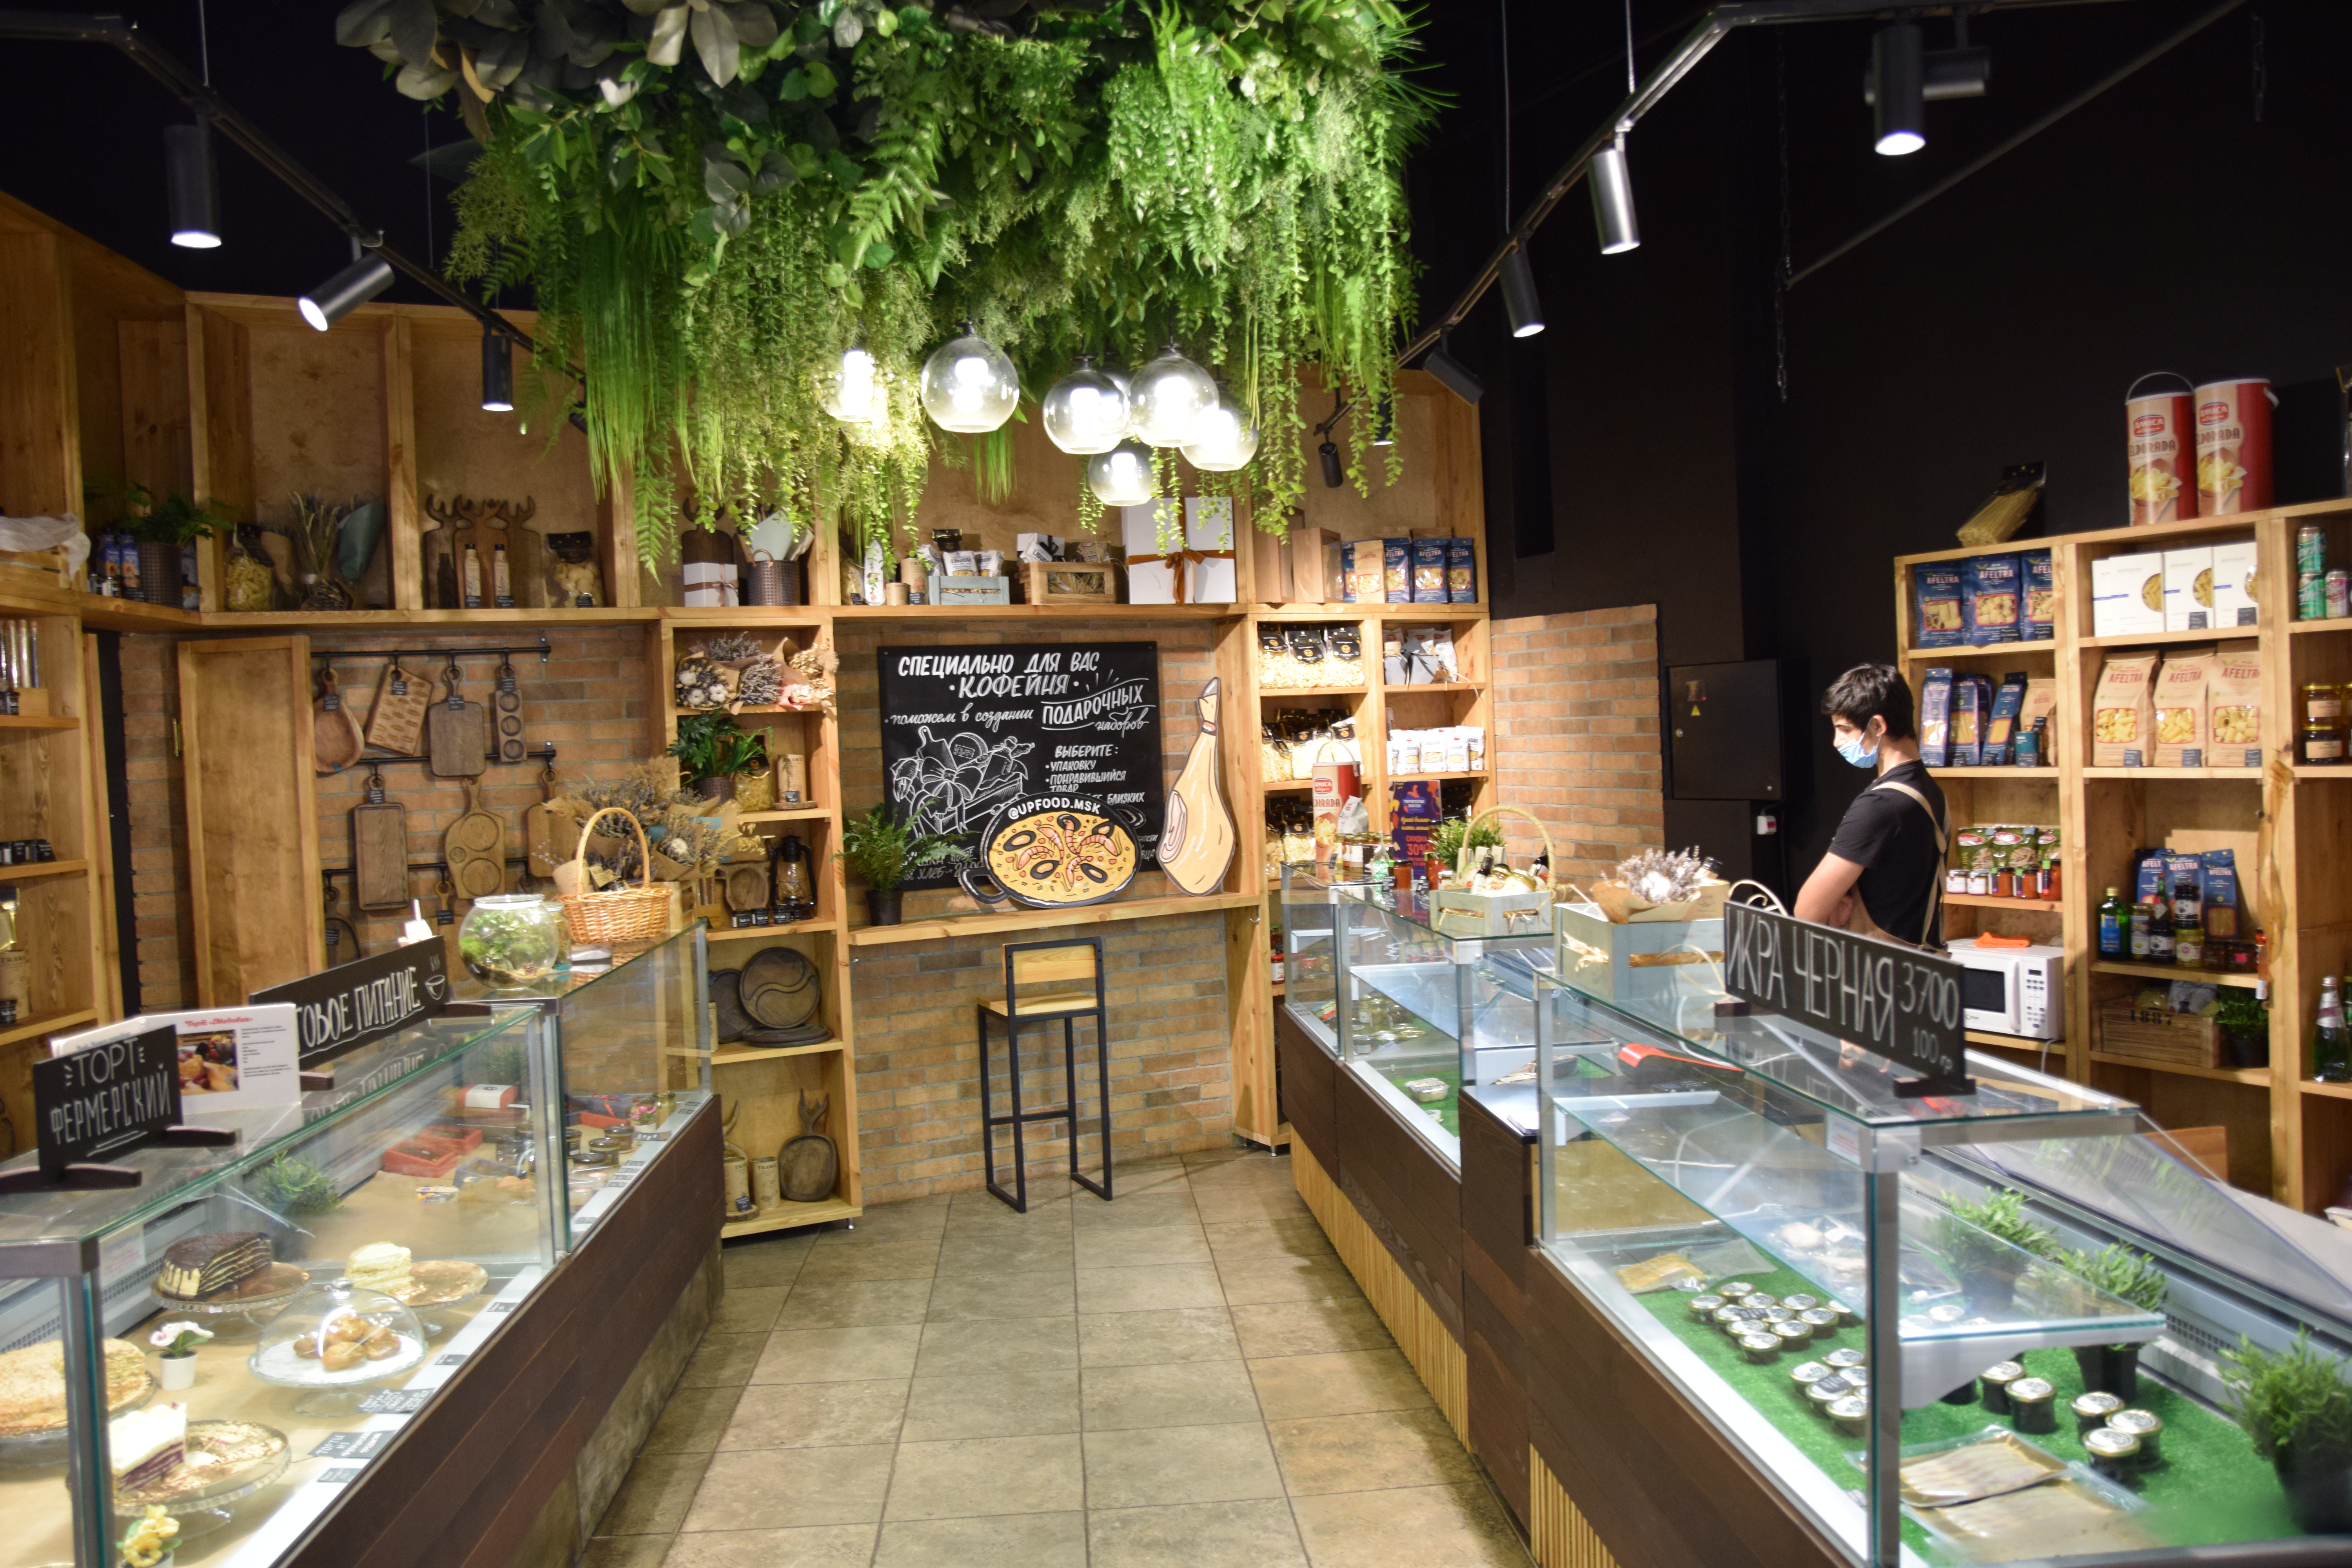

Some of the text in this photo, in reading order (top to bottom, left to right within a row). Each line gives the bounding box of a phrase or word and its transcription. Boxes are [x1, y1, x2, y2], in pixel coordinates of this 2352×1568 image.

[1979, 570, 2014, 579] AFELTRA
[898, 652, 1100, 679] СПЕЦИАЛЬНО ДЛЯ ВАС
[2168, 670, 2202, 683] AFELTRA
[958, 674, 1070, 698] КОФЕЙНЯ
[2108, 672, 2143, 684] AFELTRA
[1042, 685, 1143, 724] ПОДАРОЧНЫХ
[890, 702, 1033, 733] поможем в создании
[1094, 707, 1149, 738] наборов
[1054, 744, 1118, 758] ВЫБЕРИТЕ:
[1050, 760, 1096, 771] УПАКОВКУ
[1050, 769, 1127, 784] ПОНРАВИВШИЙСЯ
[1049, 784, 1079, 792] ТОВАР
[1107, 792, 1145, 804] БЛИЗКИХ
[1008, 797, 1101, 819] @UPFOOD.MSK
[2169, 862, 2198, 871] AFELTRA
[1726, 906, 1960, 1047] ИКРА ЧЕРНАЯ 3700
[354, 967, 421, 1031] ПИТАНИЕ
[1913, 1027, 1939, 1060] 100
[72, 1038, 139, 1087] ТОРТ
[50, 1063, 171, 1145] ФЕРМЕРСКИЙ
[316, 1436, 345, 1454] ТОРТЫ
